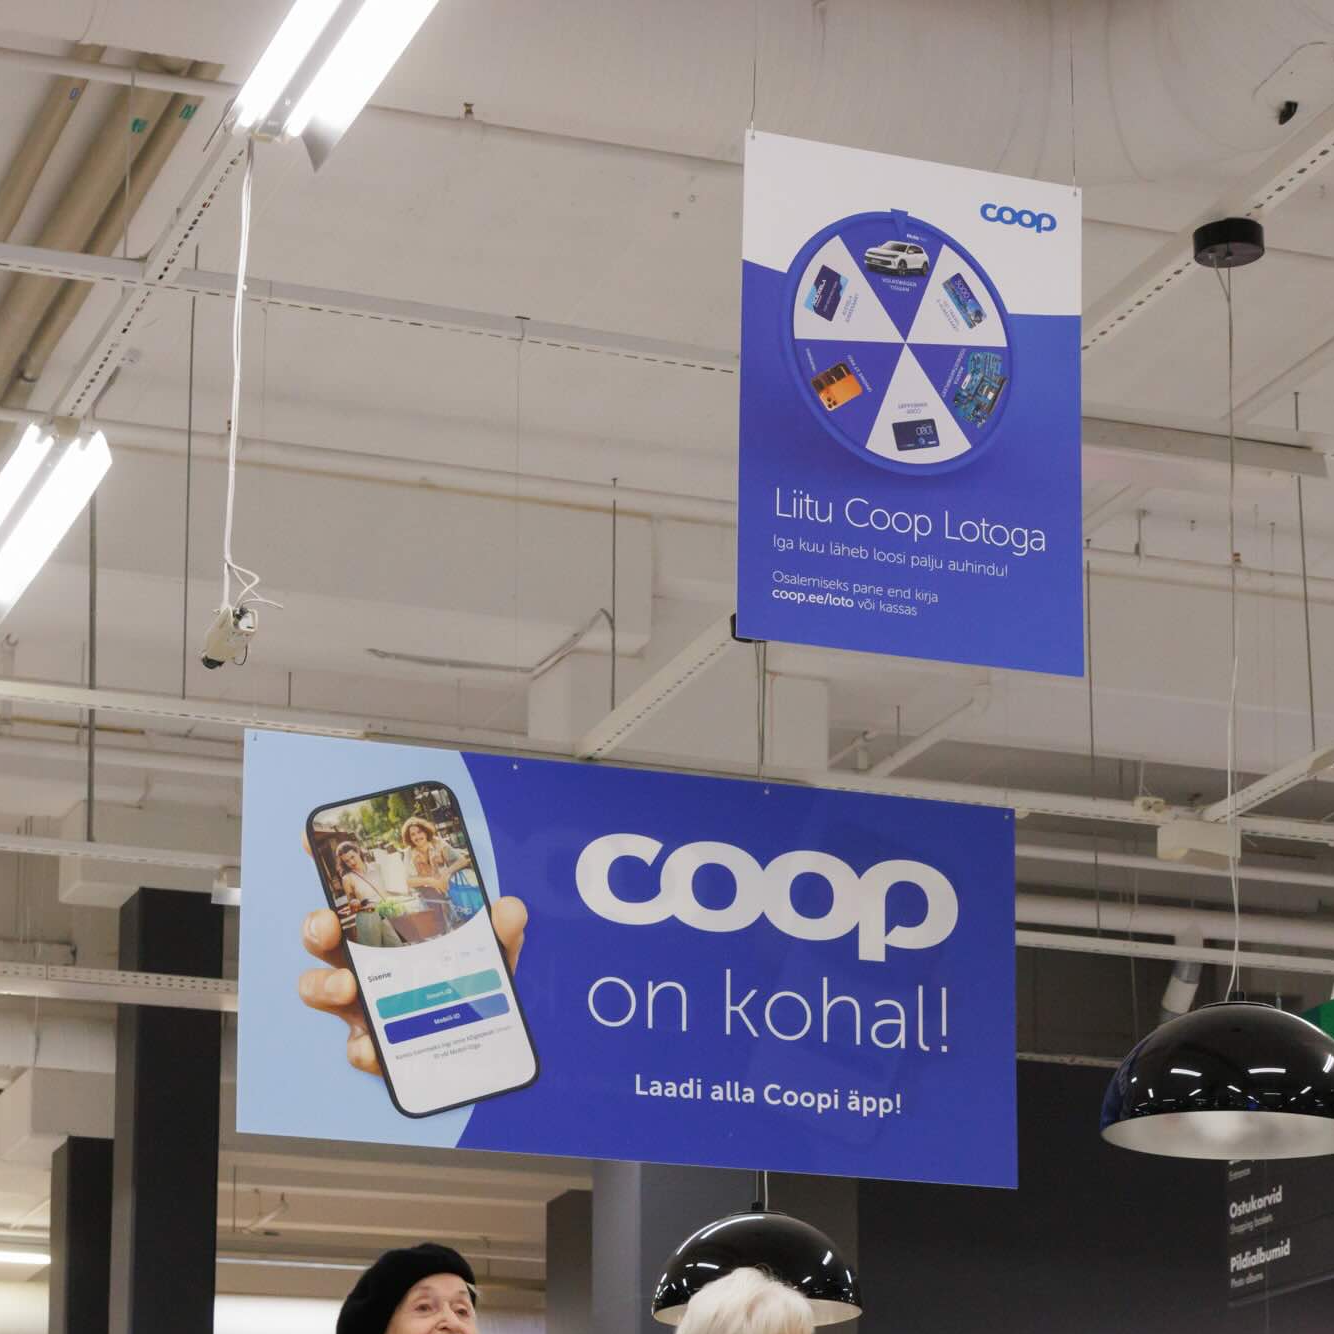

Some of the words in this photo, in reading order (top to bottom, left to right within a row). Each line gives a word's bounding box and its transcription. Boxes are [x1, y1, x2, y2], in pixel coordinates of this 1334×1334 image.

[979, 202, 1058, 234] coop
[775, 488, 833, 526] Liitu
[845, 497, 932, 542] Coop
[945, 509, 1046, 556] Lotoga
[773, 534, 795, 554] Iga
[799, 537, 824, 556] kuu
[829, 540, 868, 565] läheb
[873, 546, 906, 568] loosi
[910, 550, 945, 573] palju
[948, 554, 1008, 578] auhindu!
[772, 569, 849, 593] Osalemiseks
[852, 581, 882, 599] pane
[886, 581, 910, 599] end
[914, 584, 939, 604] kirja
[772, 590, 854, 611] coop.ee/loto
[858, 596, 875, 611] või
[878, 598, 917, 617] kassas
[575, 832, 960, 963] coop
[367, 971, 392, 983] Sisene
[588, 975, 689, 1033] on
[725, 968, 949, 1053] kohal!
[635, 1074, 702, 1100] Laadi
[710, 1078, 755, 1105] alla
[763, 1083, 840, 1115] Coopi
[848, 1087, 903, 1119] äpp!
[1229, 1185, 1283, 1218] Ostukorvid
[1230, 1238, 1291, 1273] Pildialbumid
